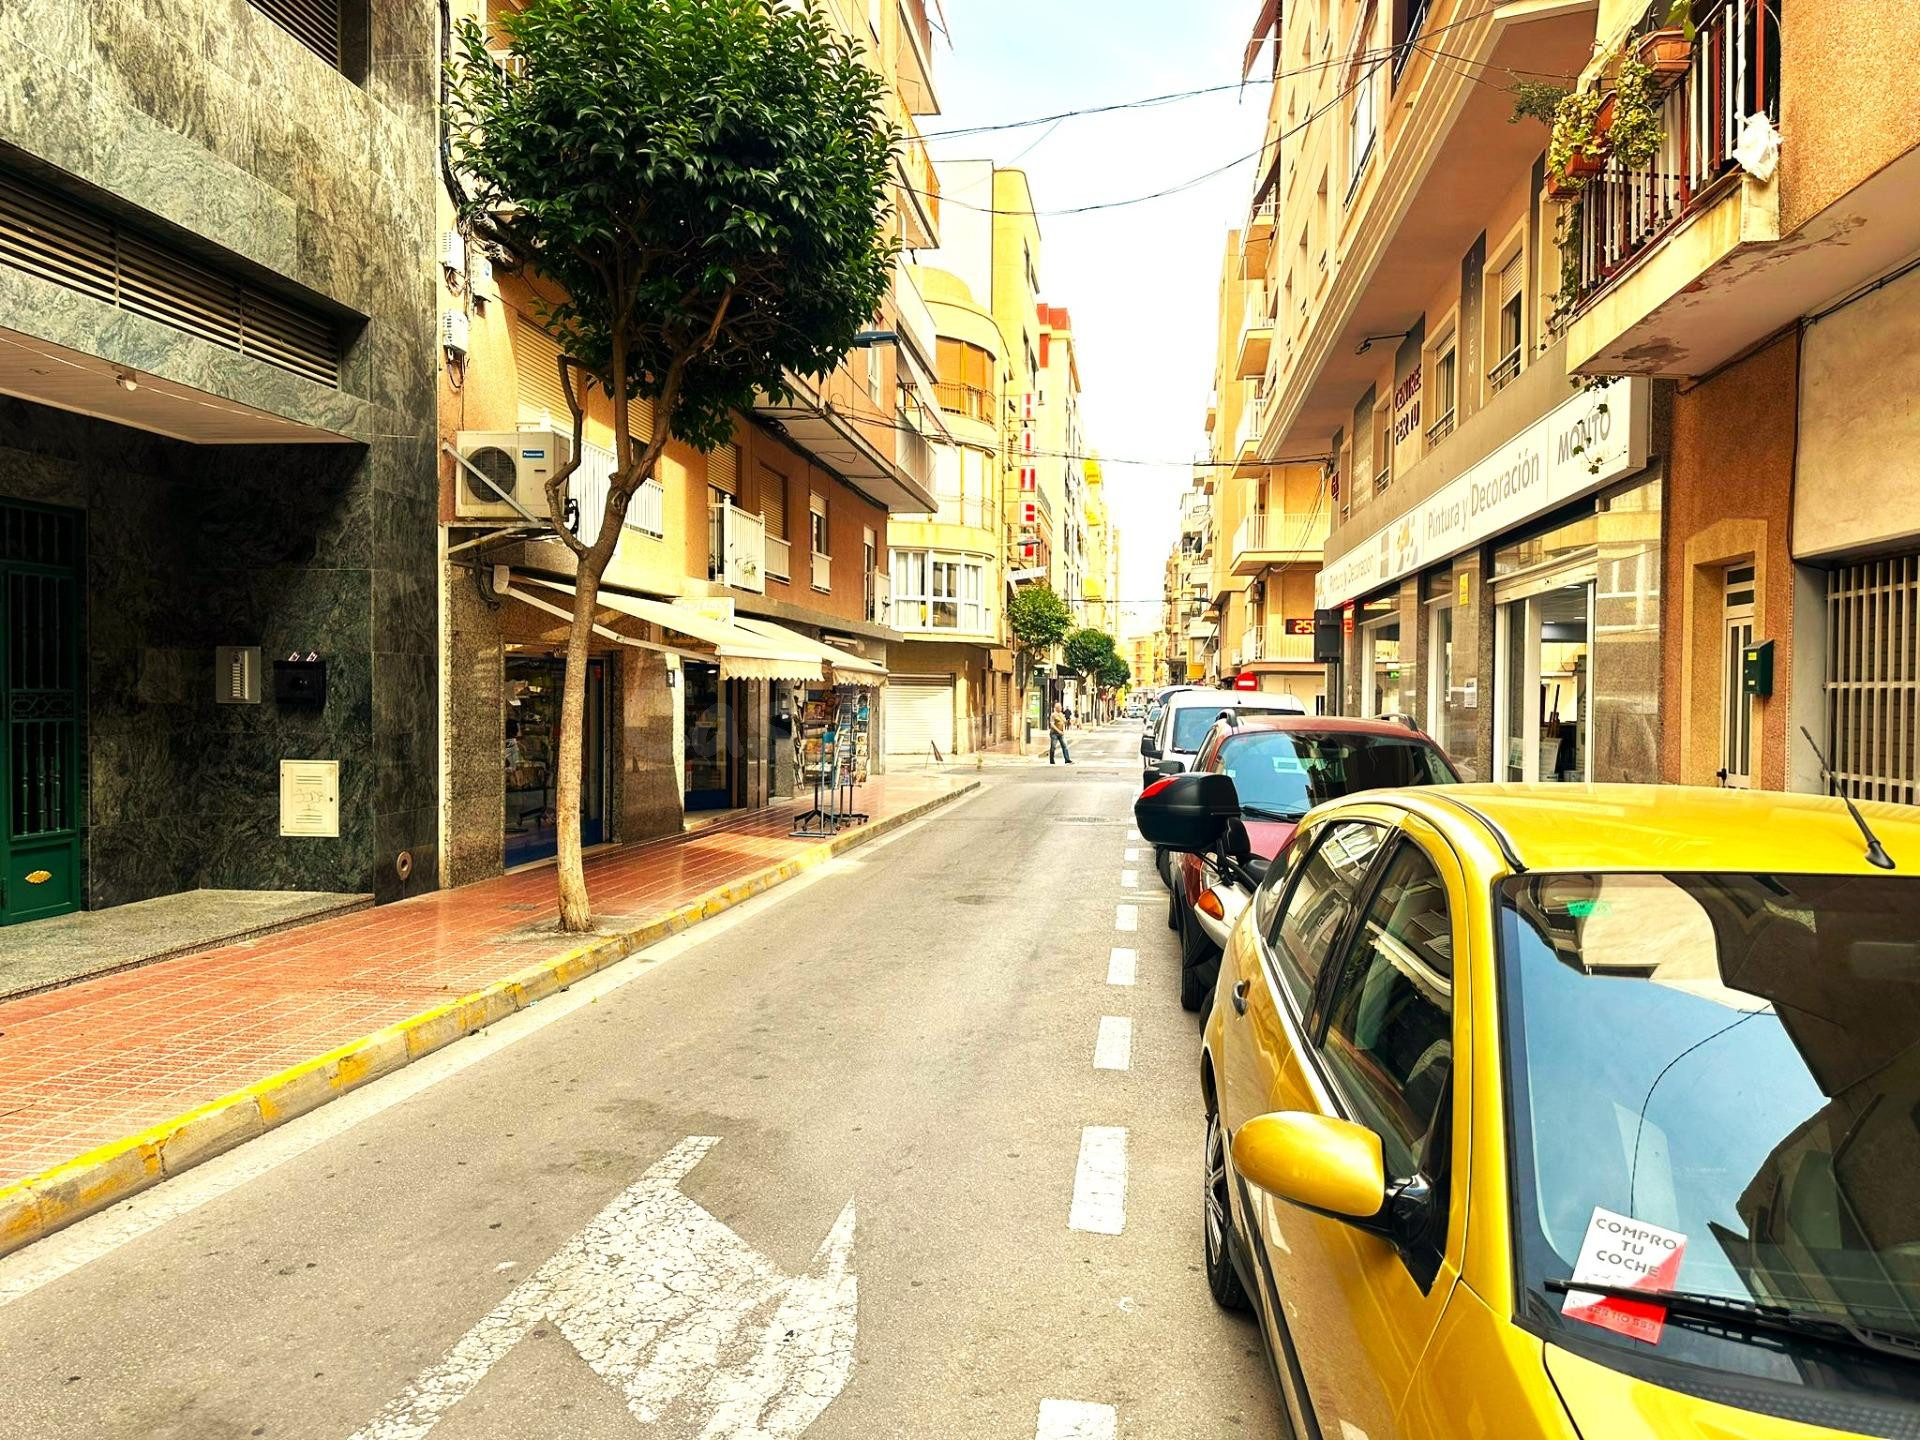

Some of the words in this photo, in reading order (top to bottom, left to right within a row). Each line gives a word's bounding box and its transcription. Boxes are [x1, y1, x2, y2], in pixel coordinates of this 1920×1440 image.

[1427, 506, 1461, 541] Pintura
[1461, 496, 1470, 532] y
[1470, 448, 1540, 517] Decoración
[1595, 1218, 1677, 1250] COMPRO
[1620, 1240, 1644, 1256] TU
[1596, 1249, 1661, 1278] COCHE
